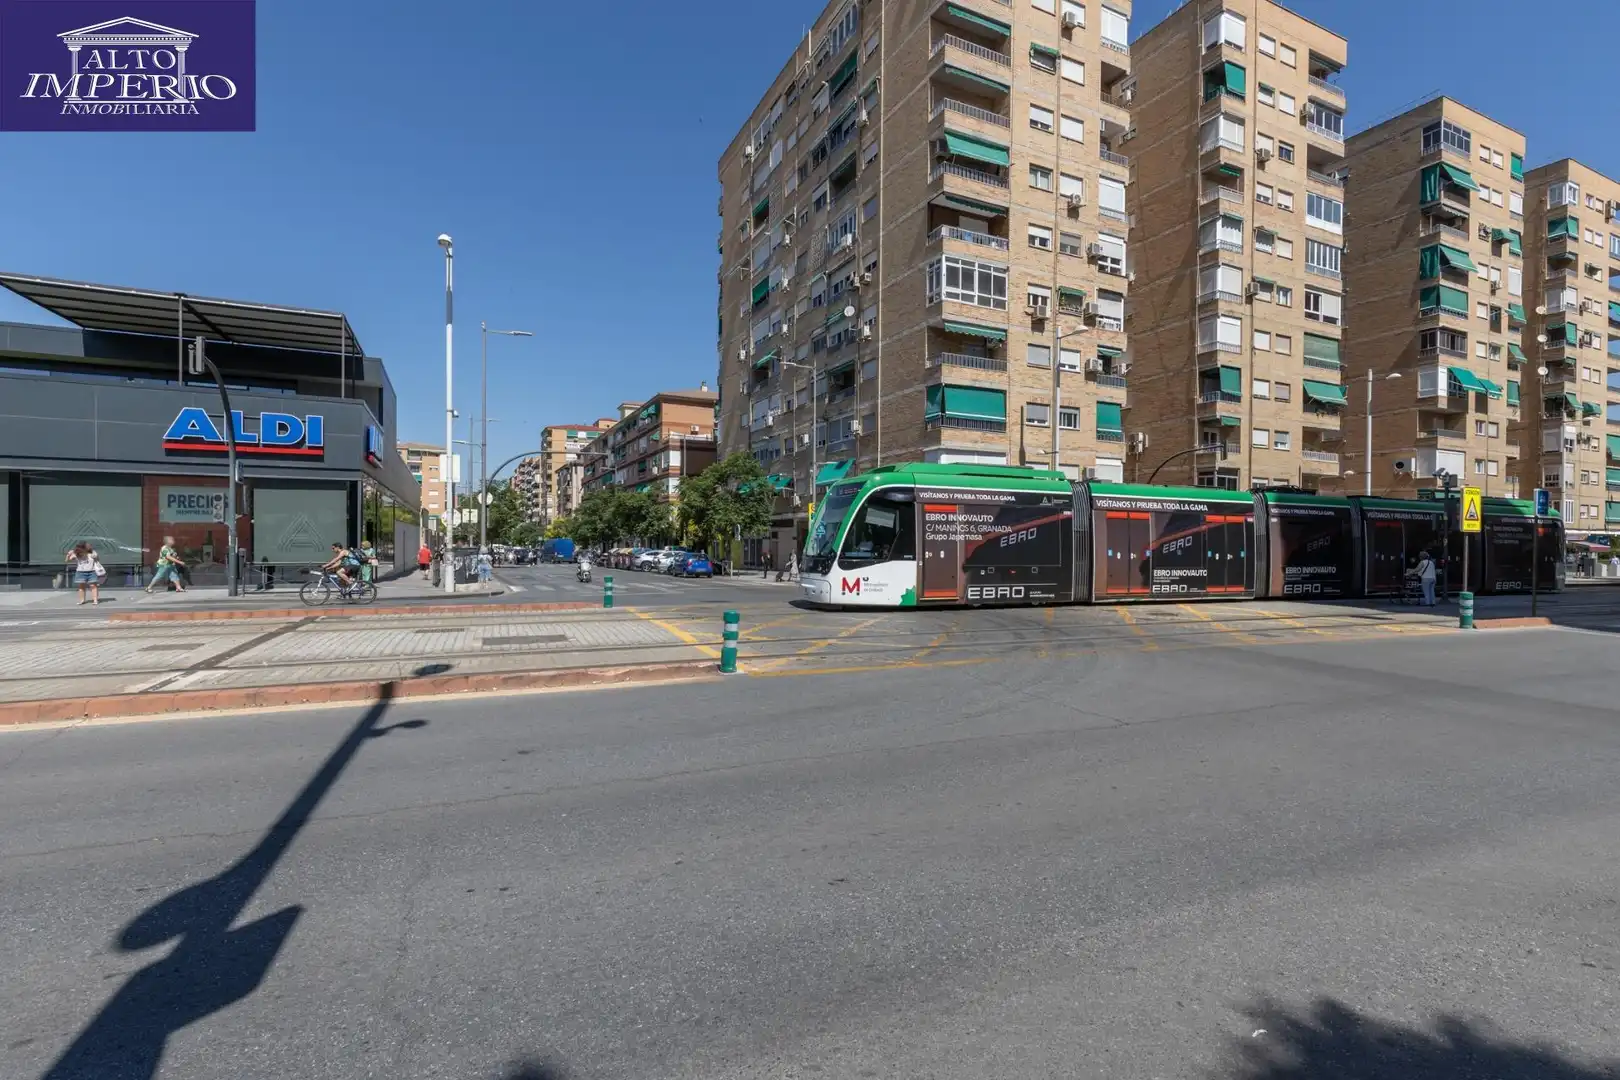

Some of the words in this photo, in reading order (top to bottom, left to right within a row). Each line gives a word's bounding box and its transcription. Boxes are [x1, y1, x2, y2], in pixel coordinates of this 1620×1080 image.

[162, 406, 324, 446] ALDI
[167, 494, 229, 508] PRECIS
[1096, 498, 1131, 508] VISÍTANOS
[948, 514, 994, 522] INNOVAUTO
[926, 524, 934, 532] C/
[925, 533, 948, 541] Grupo
[1000, 528, 1037, 547] EBRO
[1162, 536, 1192, 553] EBRO
[842, 577, 860, 593] M
[1152, 584, 1188, 593] EBRO
[1284, 584, 1321, 594] EBRO
[968, 586, 1024, 599] EBRO
